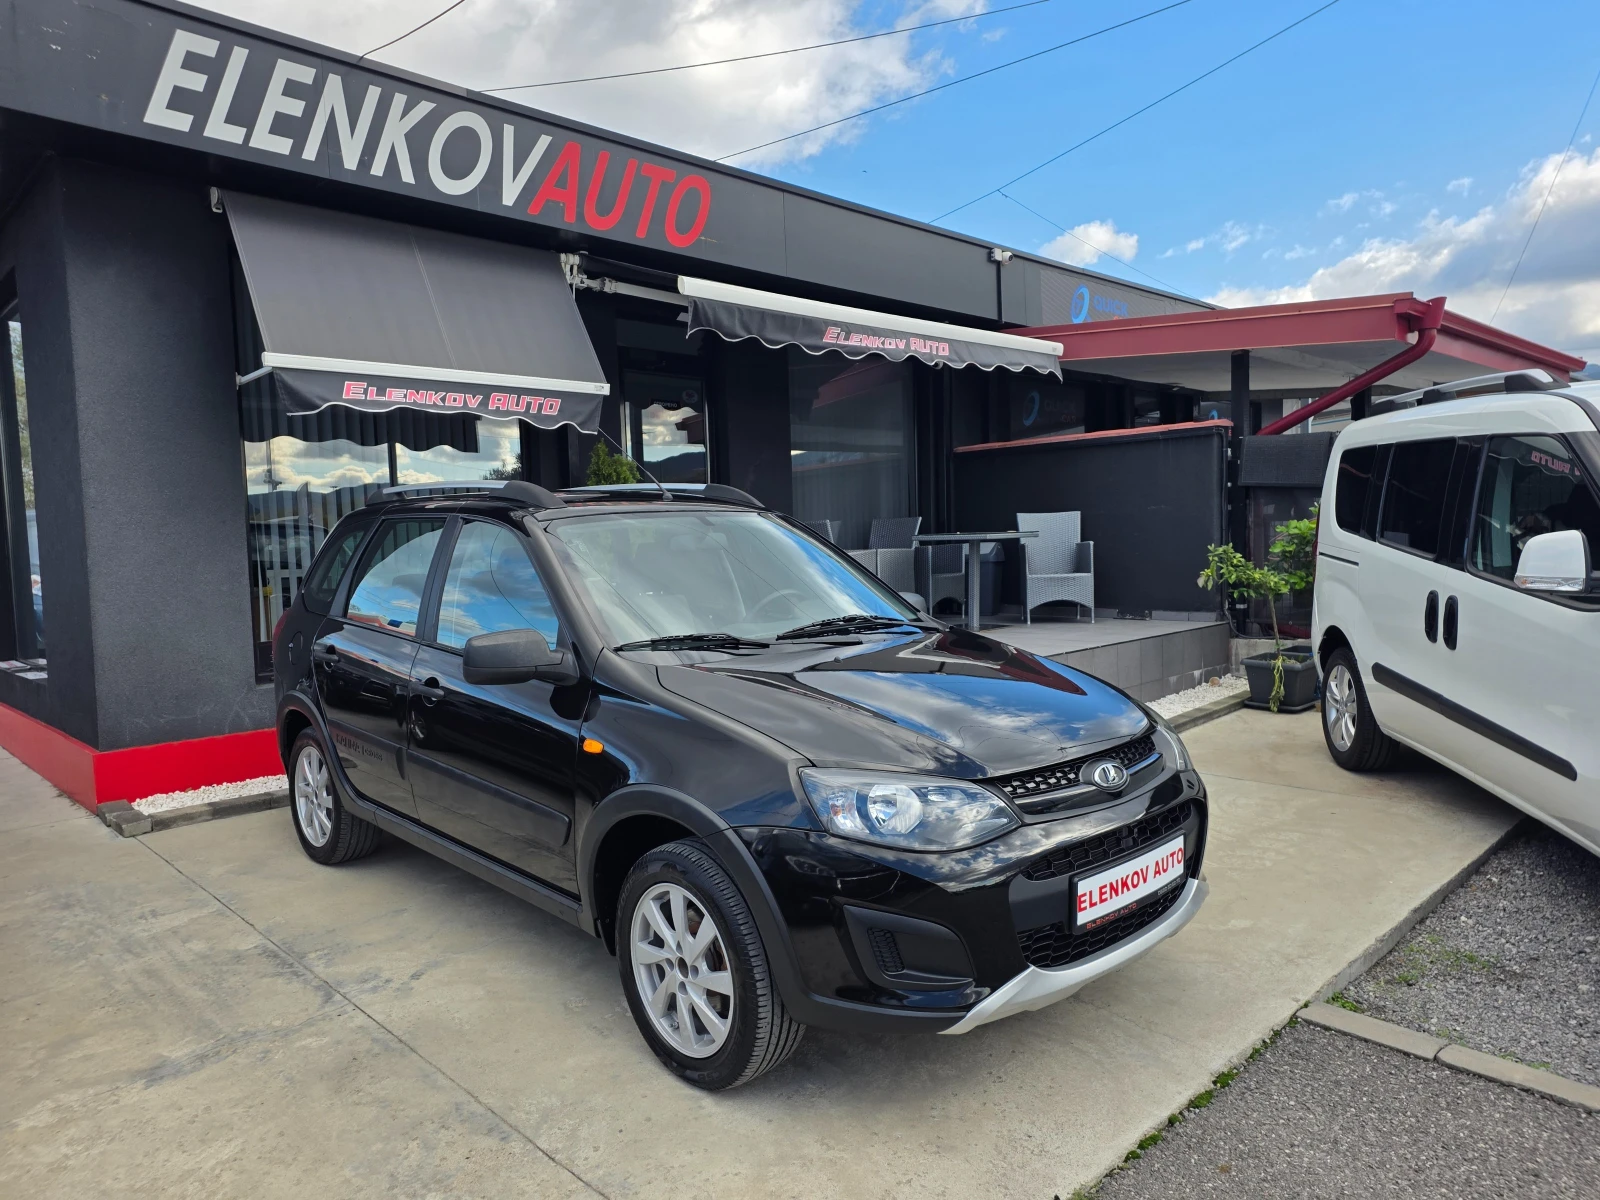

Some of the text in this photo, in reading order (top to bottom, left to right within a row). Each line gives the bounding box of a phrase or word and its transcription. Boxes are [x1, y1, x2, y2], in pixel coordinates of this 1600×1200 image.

[1093, 294, 1129, 317] QUICK
[822, 326, 950, 356] ELENKOV AUTO
[342, 380, 561, 416] ELENKOV AUTO
[1077, 864, 1149, 913] ELENKOV
[1153, 847, 1184, 879] AUTO
[1086, 902, 1137, 930] ELENKOV AUTO
